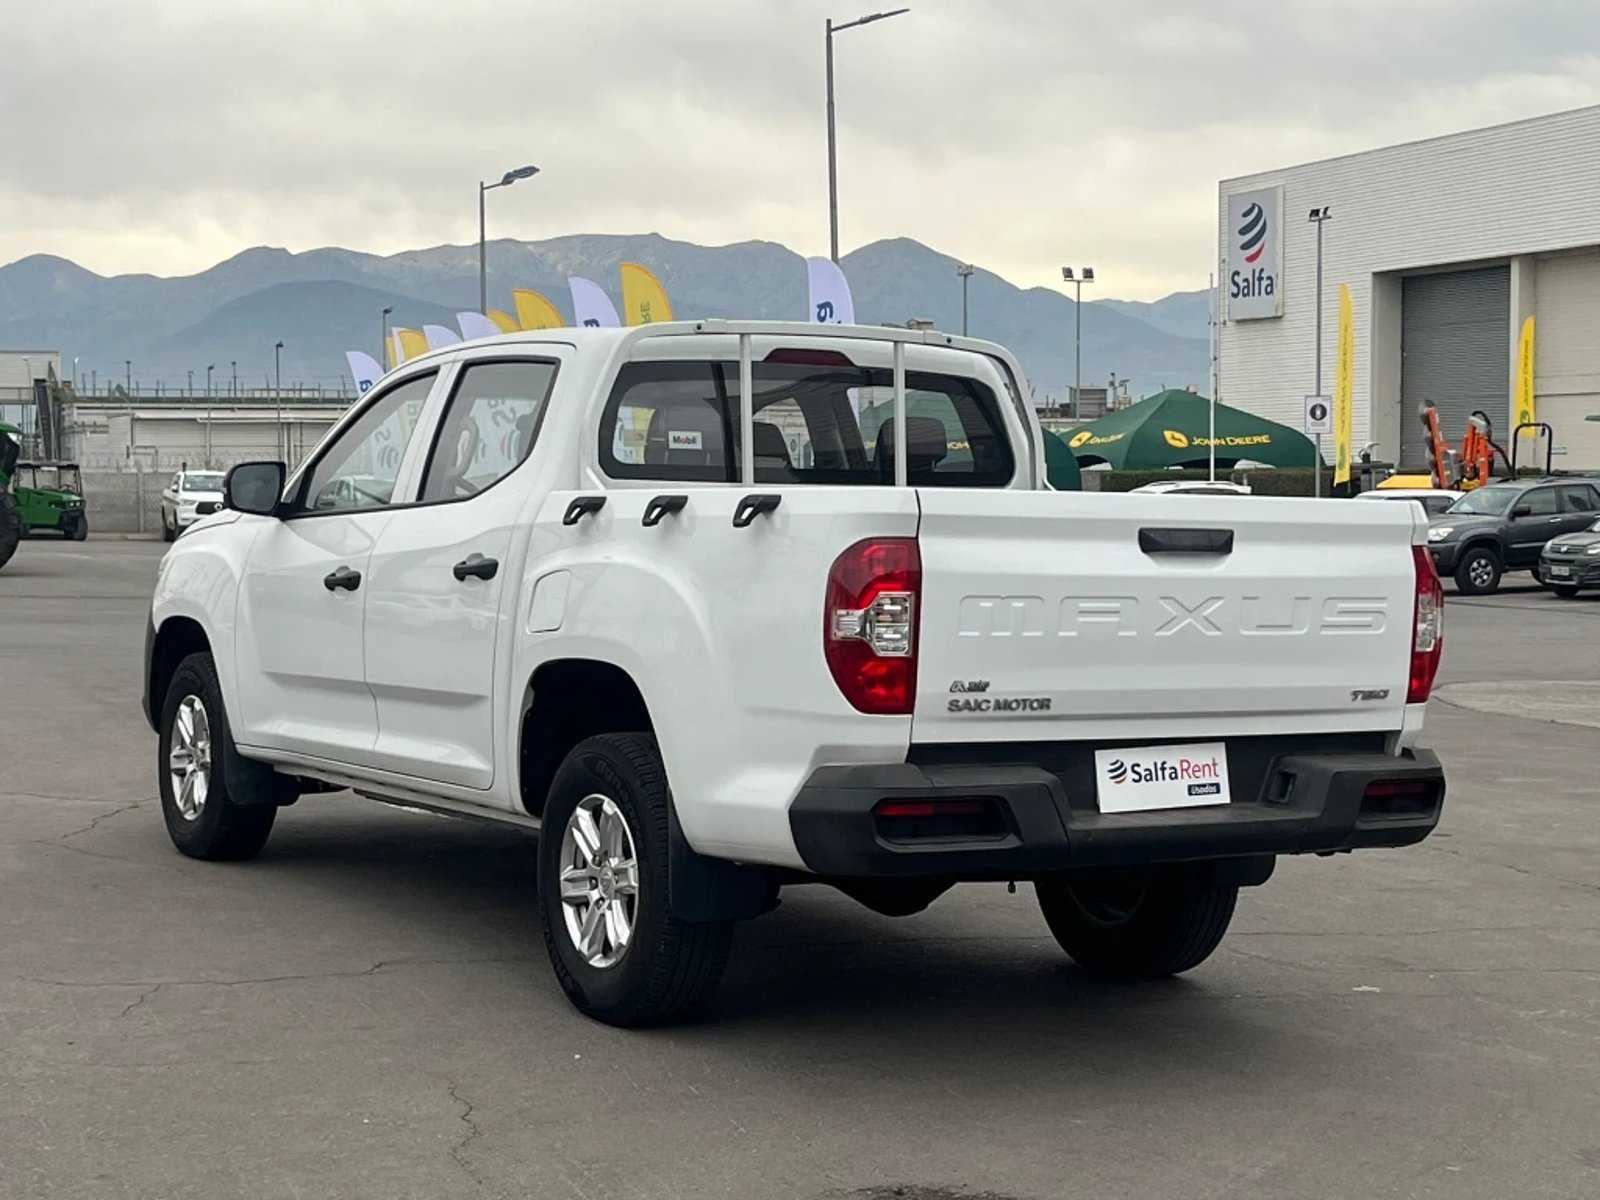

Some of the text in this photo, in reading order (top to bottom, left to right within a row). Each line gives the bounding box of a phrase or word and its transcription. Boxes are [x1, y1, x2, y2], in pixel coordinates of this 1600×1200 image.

[1230, 268, 1274, 299] Salfa
[1226, 434, 1272, 447] DEERE
[958, 595, 1389, 637] MAXUS
[947, 697, 1052, 712] SAIC MOTOR
[1130, 757, 1220, 784] SalfaRent
